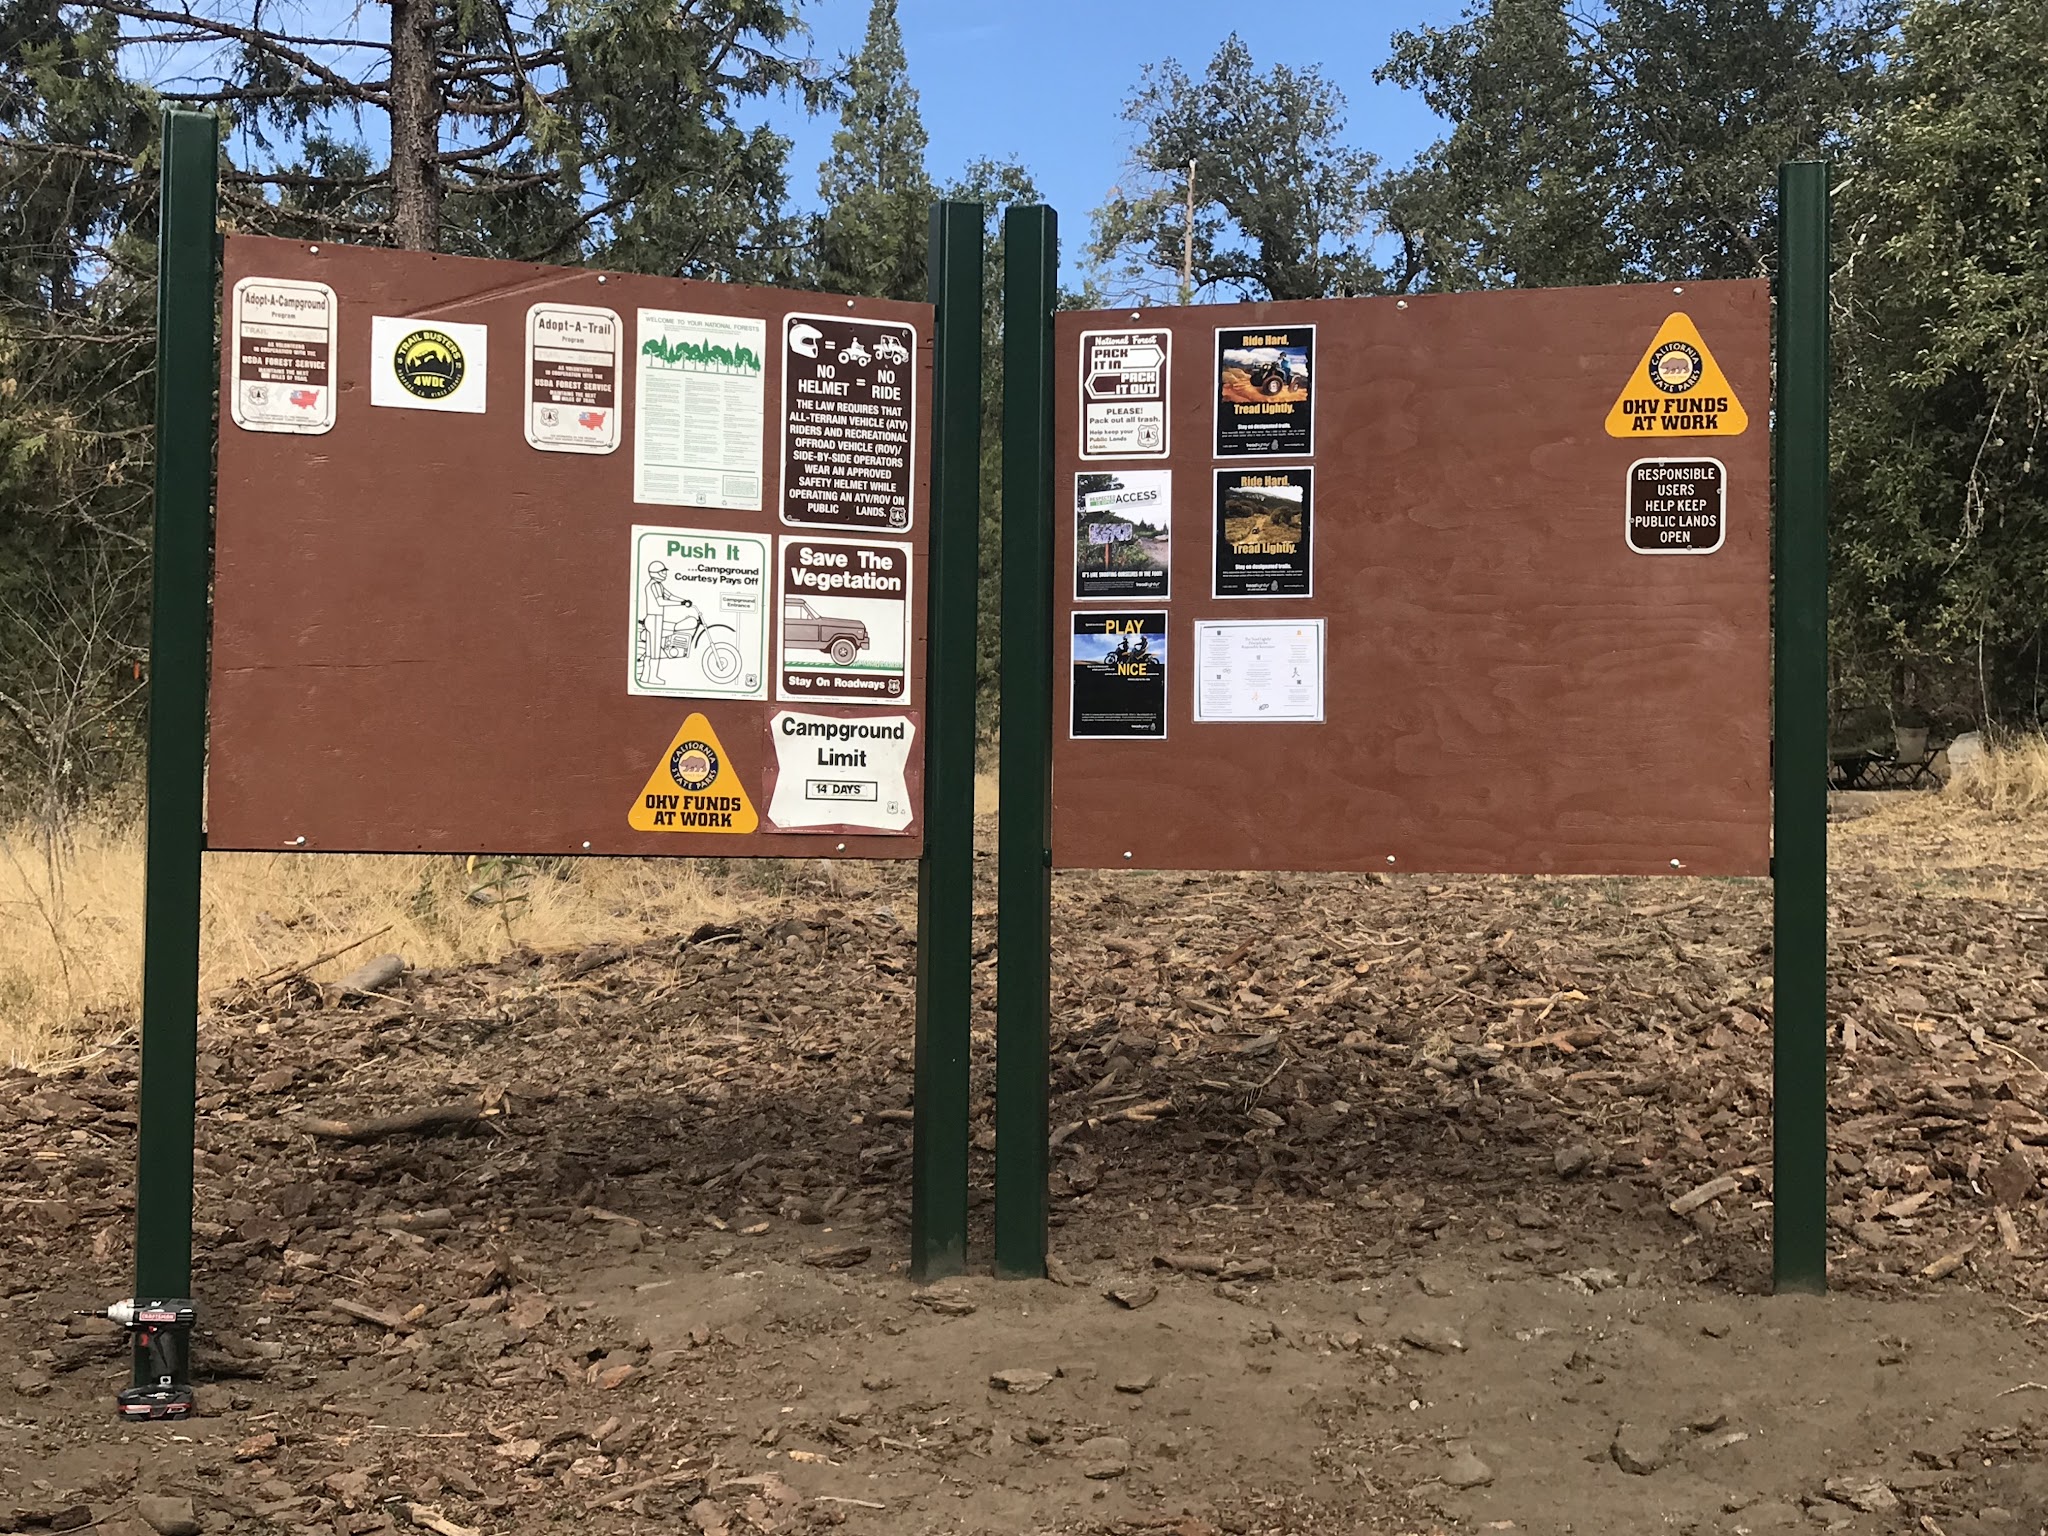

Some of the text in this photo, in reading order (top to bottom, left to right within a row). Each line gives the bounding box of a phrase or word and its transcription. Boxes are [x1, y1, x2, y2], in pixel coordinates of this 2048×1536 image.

[539, 318, 611, 335] Adopt-A-Trail
[398, 332, 461, 359] TRAIL BUSTERS
[1095, 335, 1157, 345] National Forest
[1243, 336, 1263, 346] Ride
[1095, 349, 1128, 358] PACK
[1652, 343, 1699, 365] CALIFORNIA
[242, 356, 326, 369] USDA FOREST SERVICE
[1094, 361, 1106, 369] IT
[817, 364, 835, 379] NO
[878, 370, 895, 384] NO
[1121, 372, 1155, 383] PACK
[535, 379, 612, 392] USDA FOREST SERVICE
[798, 379, 850, 396] HELMET
[1651, 370, 1700, 392] STATE PARKS
[872, 385, 901, 400] RIDE
[1116, 384, 1156, 394] IT OUT
[796, 399, 902, 416] THE LAW REQUIRES THAT
[1234, 403, 1295, 414] Tread Lightly.
[1623, 398, 1728, 414] OHV FUNDS
[789, 412, 908, 432] ALL-TERRAIN VEHICLE (ATV)
[1632, 414, 1718, 431] AT WORK
[790, 424, 908, 442] RIDERS AND RECREATIONAL
[795, 438, 902, 456] OFFROAD VEHICLE (ROV)/
[793, 450, 903, 467] SIDE-BY-SIDE OPERATORS
[805, 464, 892, 479] WEAR AN APPROVED
[1638, 468, 1715, 480] RESPONSIBLE
[799, 477, 896, 492] SAFETY HELMET WHILE
[1241, 476, 1262, 487] Ride
[789, 489, 904, 506] OPERATING AN ATV/ROV ON
[1116, 490, 1157, 503] ACCESS
[1658, 484, 1695, 496] USERS
[807, 503, 886, 517] PUBLIC LANDS.
[1646, 499, 1707, 512] HELP KEEP
[1635, 515, 1717, 528] PUBLIC LANDS
[1660, 531, 1690, 543] OPEN
[667, 540, 740, 561] Push It
[1232, 542, 1297, 554] Tread Lightly.
[800, 547, 893, 570] Save The
[674, 573, 717, 584] Courtesy
[720, 576, 741, 585] Pays
[791, 567, 901, 591] Vegetation
[1106, 620, 1144, 634] PLAY
[1118, 663, 1147, 676] NICE
[789, 676, 885, 690] Stay On Roadways
[782, 717, 904, 741] Campground
[673, 742, 716, 763] CALIFORNIA
[818, 748, 866, 767] Limit
[672, 768, 716, 789] STATE PARKS
[816, 785, 860, 794] 14 DAYS
[646, 794, 741, 811] OHV FUNDS
[654, 811, 732, 827] AT WORK
